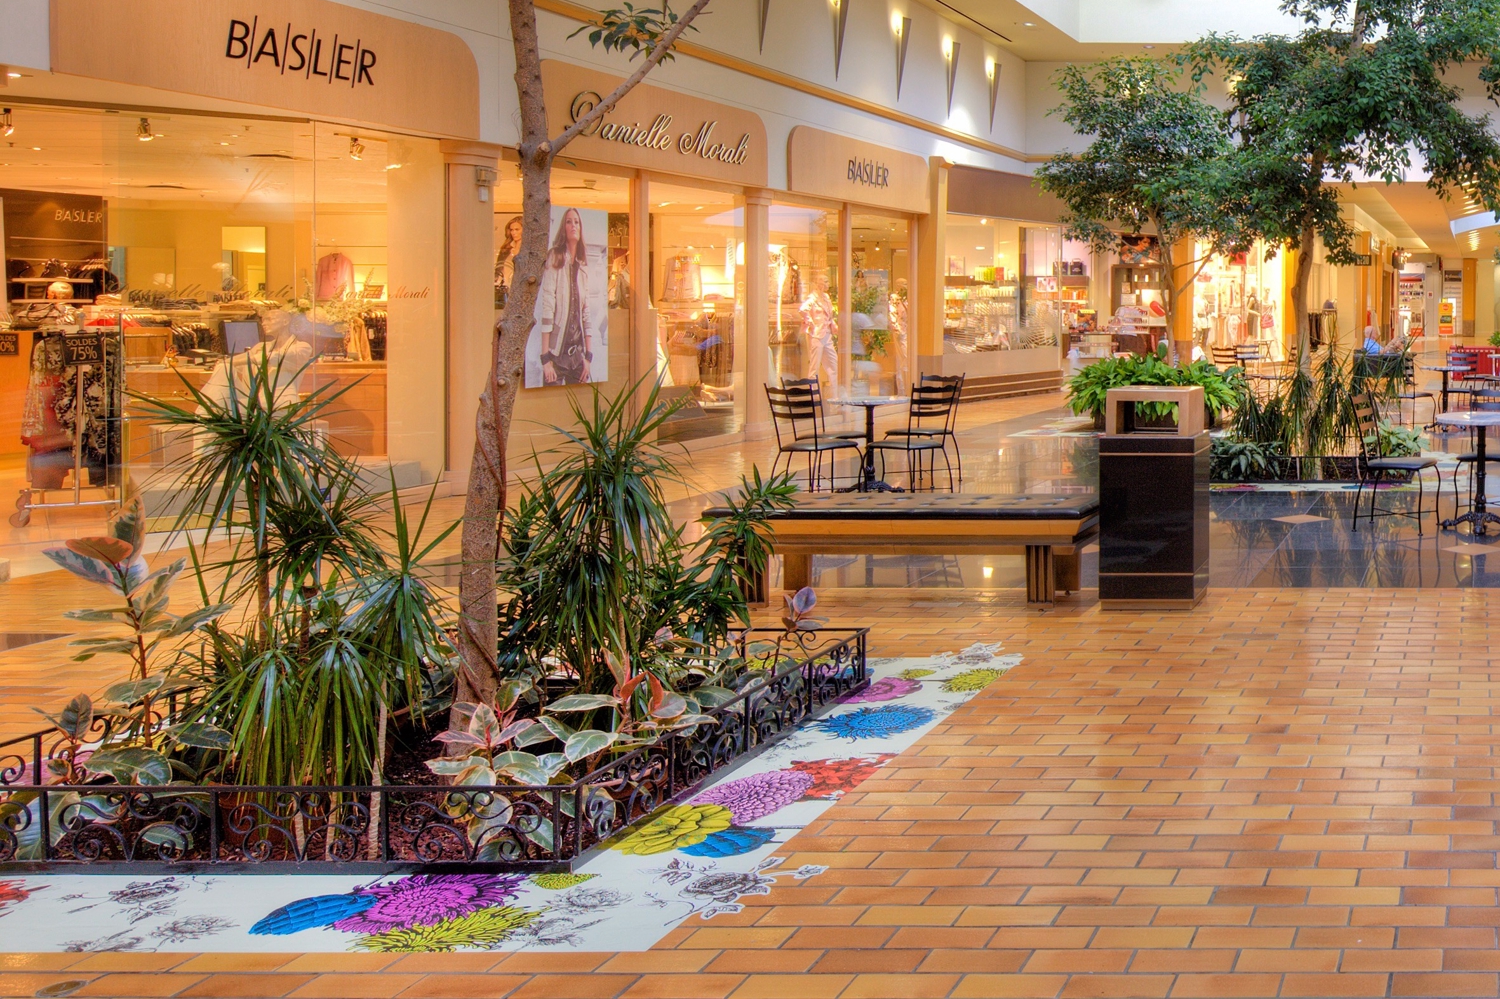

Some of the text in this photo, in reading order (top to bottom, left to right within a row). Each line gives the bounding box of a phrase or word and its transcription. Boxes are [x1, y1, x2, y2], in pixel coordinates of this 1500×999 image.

[564, 89, 751, 166] Danielle Morali
[388, 285, 431, 300] Morali
[66, 338, 98, 347] SOLDES
[69, 346, 98, 361] 75%
